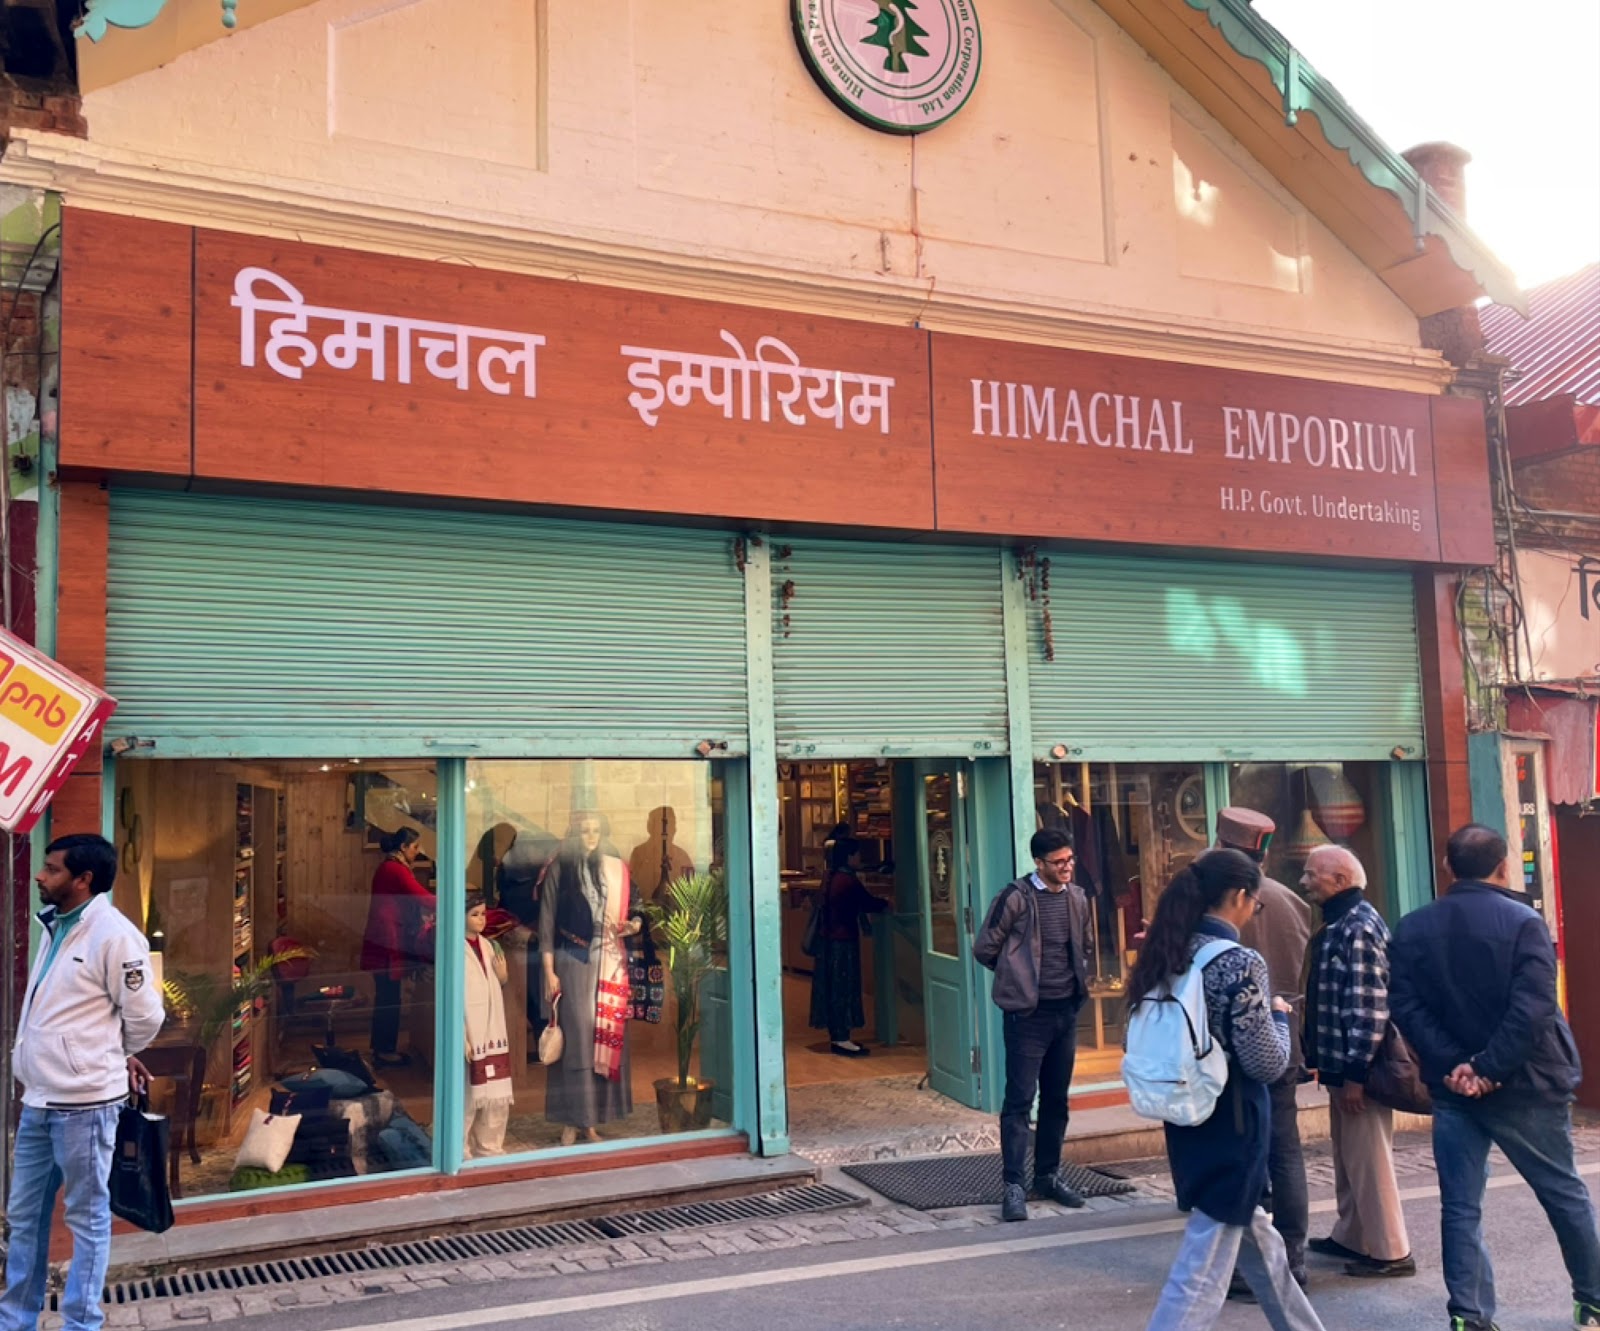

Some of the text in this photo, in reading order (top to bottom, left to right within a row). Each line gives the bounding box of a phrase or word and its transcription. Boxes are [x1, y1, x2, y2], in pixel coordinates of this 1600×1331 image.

[812, 34, 864, 100] Himachal
[942, 26, 974, 101] Corporation
[918, 97, 945, 115] Ltd.
[230, 266, 895, 434] हिमाचल इम्पोरियम
[970, 379, 1418, 477] HIMACHAL EMPORIUM
[1220, 487, 1422, 532] H.P. Govt. Undertaking
[0, 680, 66, 728] pnb
